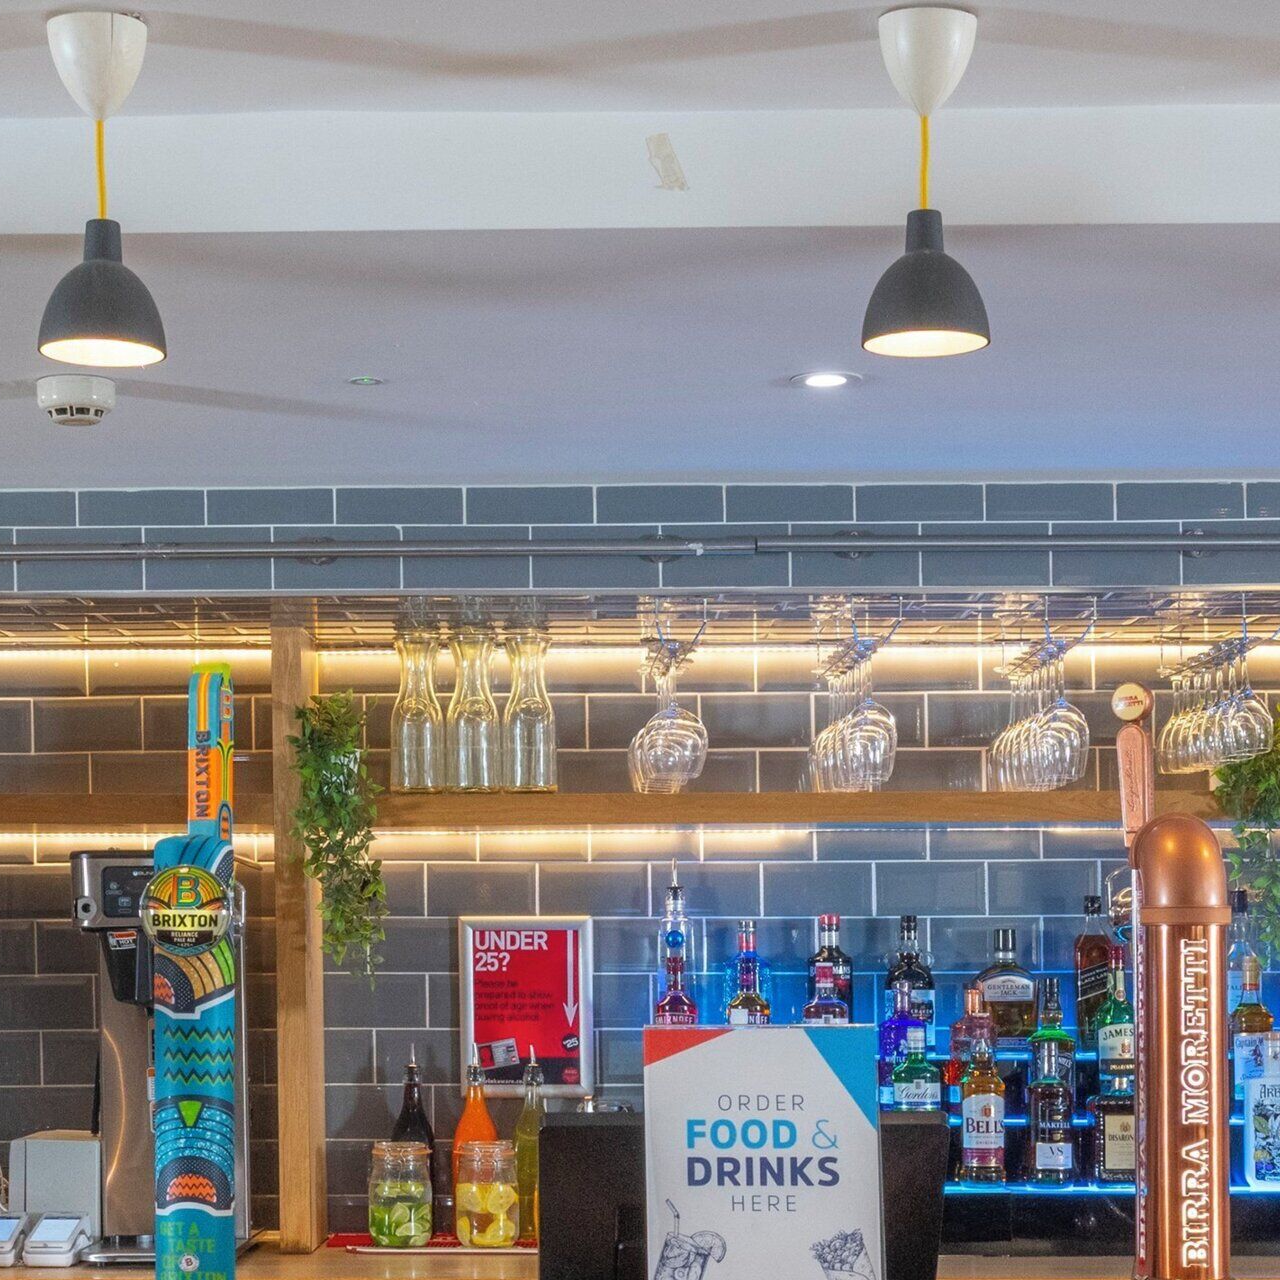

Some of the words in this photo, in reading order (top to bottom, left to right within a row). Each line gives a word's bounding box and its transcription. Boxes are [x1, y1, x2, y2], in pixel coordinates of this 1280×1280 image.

[195, 730, 212, 818] BRIXTON
[152, 914, 218, 928] BRIXTON
[474, 931, 548, 951] UNDER
[475, 952, 511, 972] 25?
[655, 1015, 694, 1024] SMIRNOFF
[1181, 937, 1208, 1126] MORETTI
[717, 1094, 805, 1112] ORDER
[686, 1119, 797, 1149] FOOD
[812, 1119, 839, 1149] &
[687, 1156, 840, 1187] DRINKS
[731, 1195, 797, 1212] HERE
[1181, 1138, 1208, 1269] BIRRA
